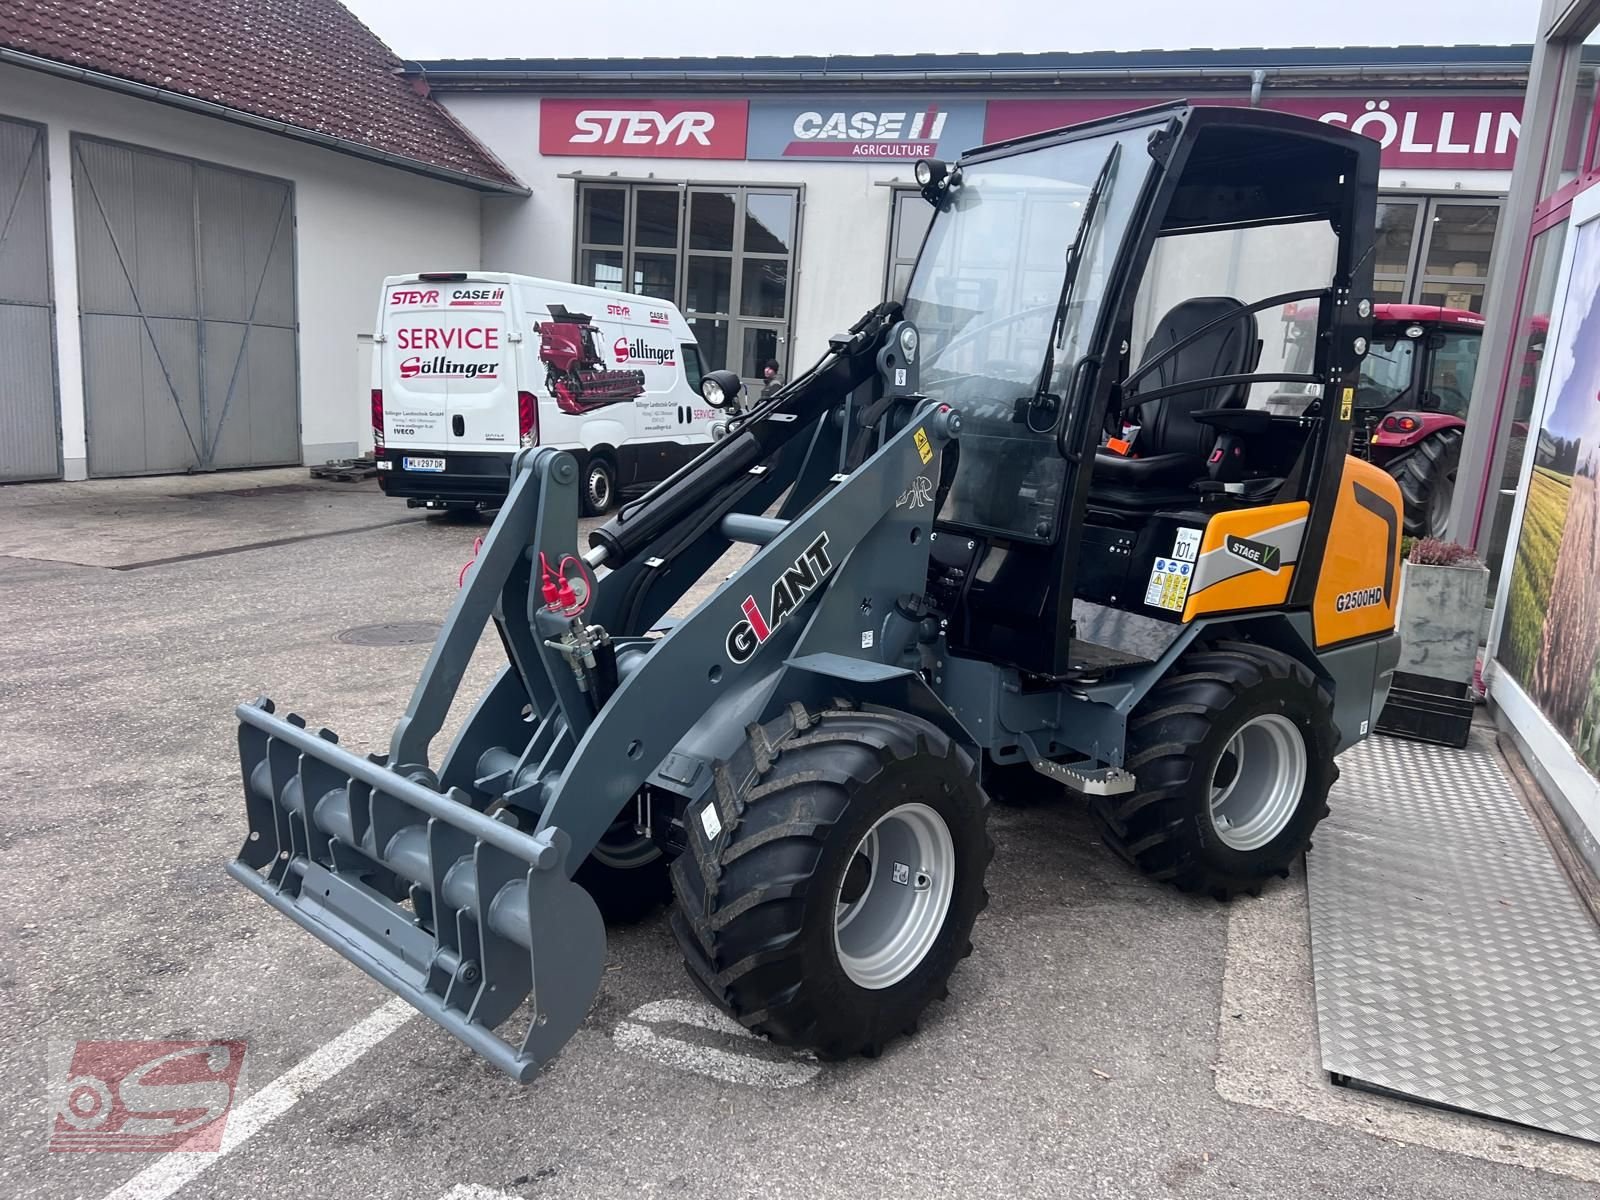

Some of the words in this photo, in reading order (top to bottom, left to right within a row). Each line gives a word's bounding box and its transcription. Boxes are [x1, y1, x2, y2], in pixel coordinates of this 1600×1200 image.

[568, 110, 715, 146] STEYR
[793, 112, 906, 139] CASE
[1316, 100, 1521, 154] ÖLLIN
[852, 144, 930, 156] AGRICULTURE
[390, 290, 440, 304] STEYR
[452, 290, 490, 300] CASE
[607, 304, 630, 316] STEYR
[397, 328, 499, 349] SERVICE
[614, 337, 675, 364] Söllinger
[400, 356, 499, 379] Söllinger
[693, 409, 715, 420] SERVICE
[1176, 541, 1191, 558] 101
[1232, 542, 1261, 562] STAGE
[1262, 545, 1280, 564] V
[1336, 587, 1382, 612] G2500HD
